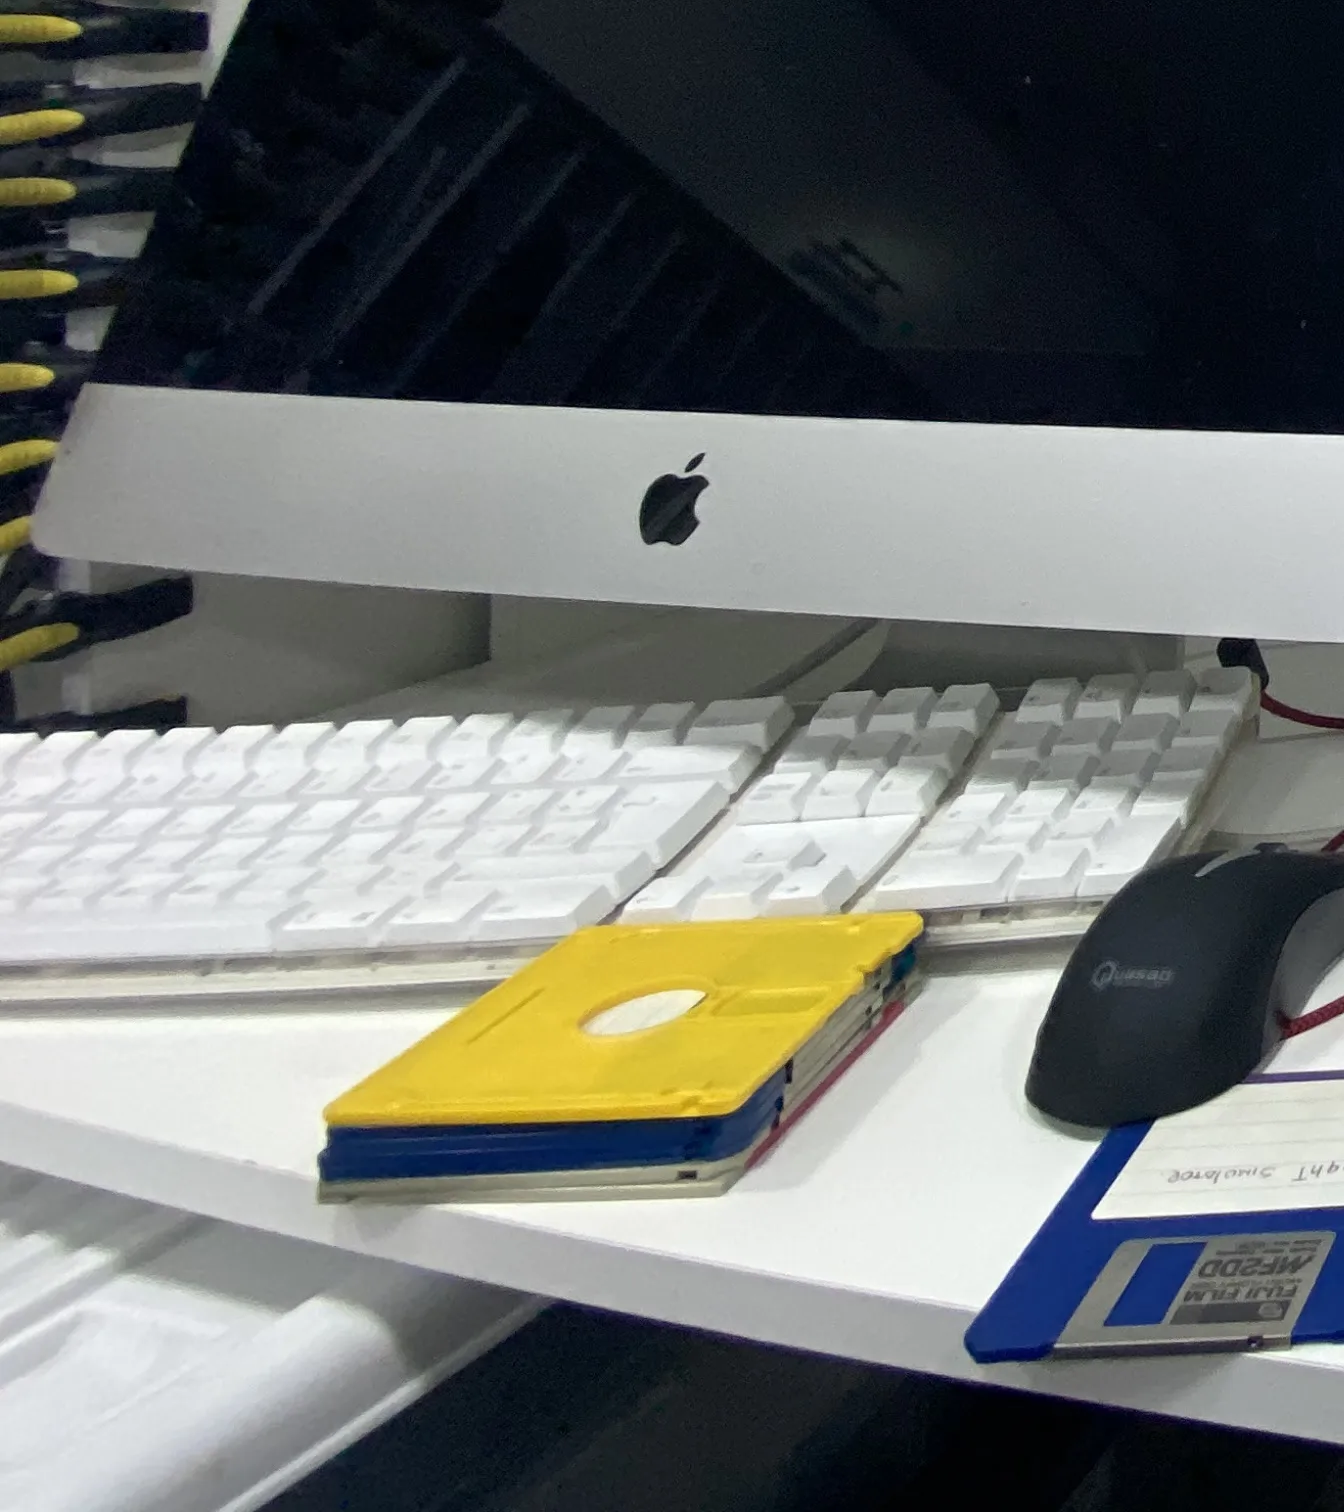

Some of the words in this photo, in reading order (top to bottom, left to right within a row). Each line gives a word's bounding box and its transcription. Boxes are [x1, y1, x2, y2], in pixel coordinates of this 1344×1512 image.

[1198, 1254, 1317, 1279] MF2DD
[1183, 1288, 1238, 1303] FILM
[1244, 1285, 1298, 1299] FUJI
